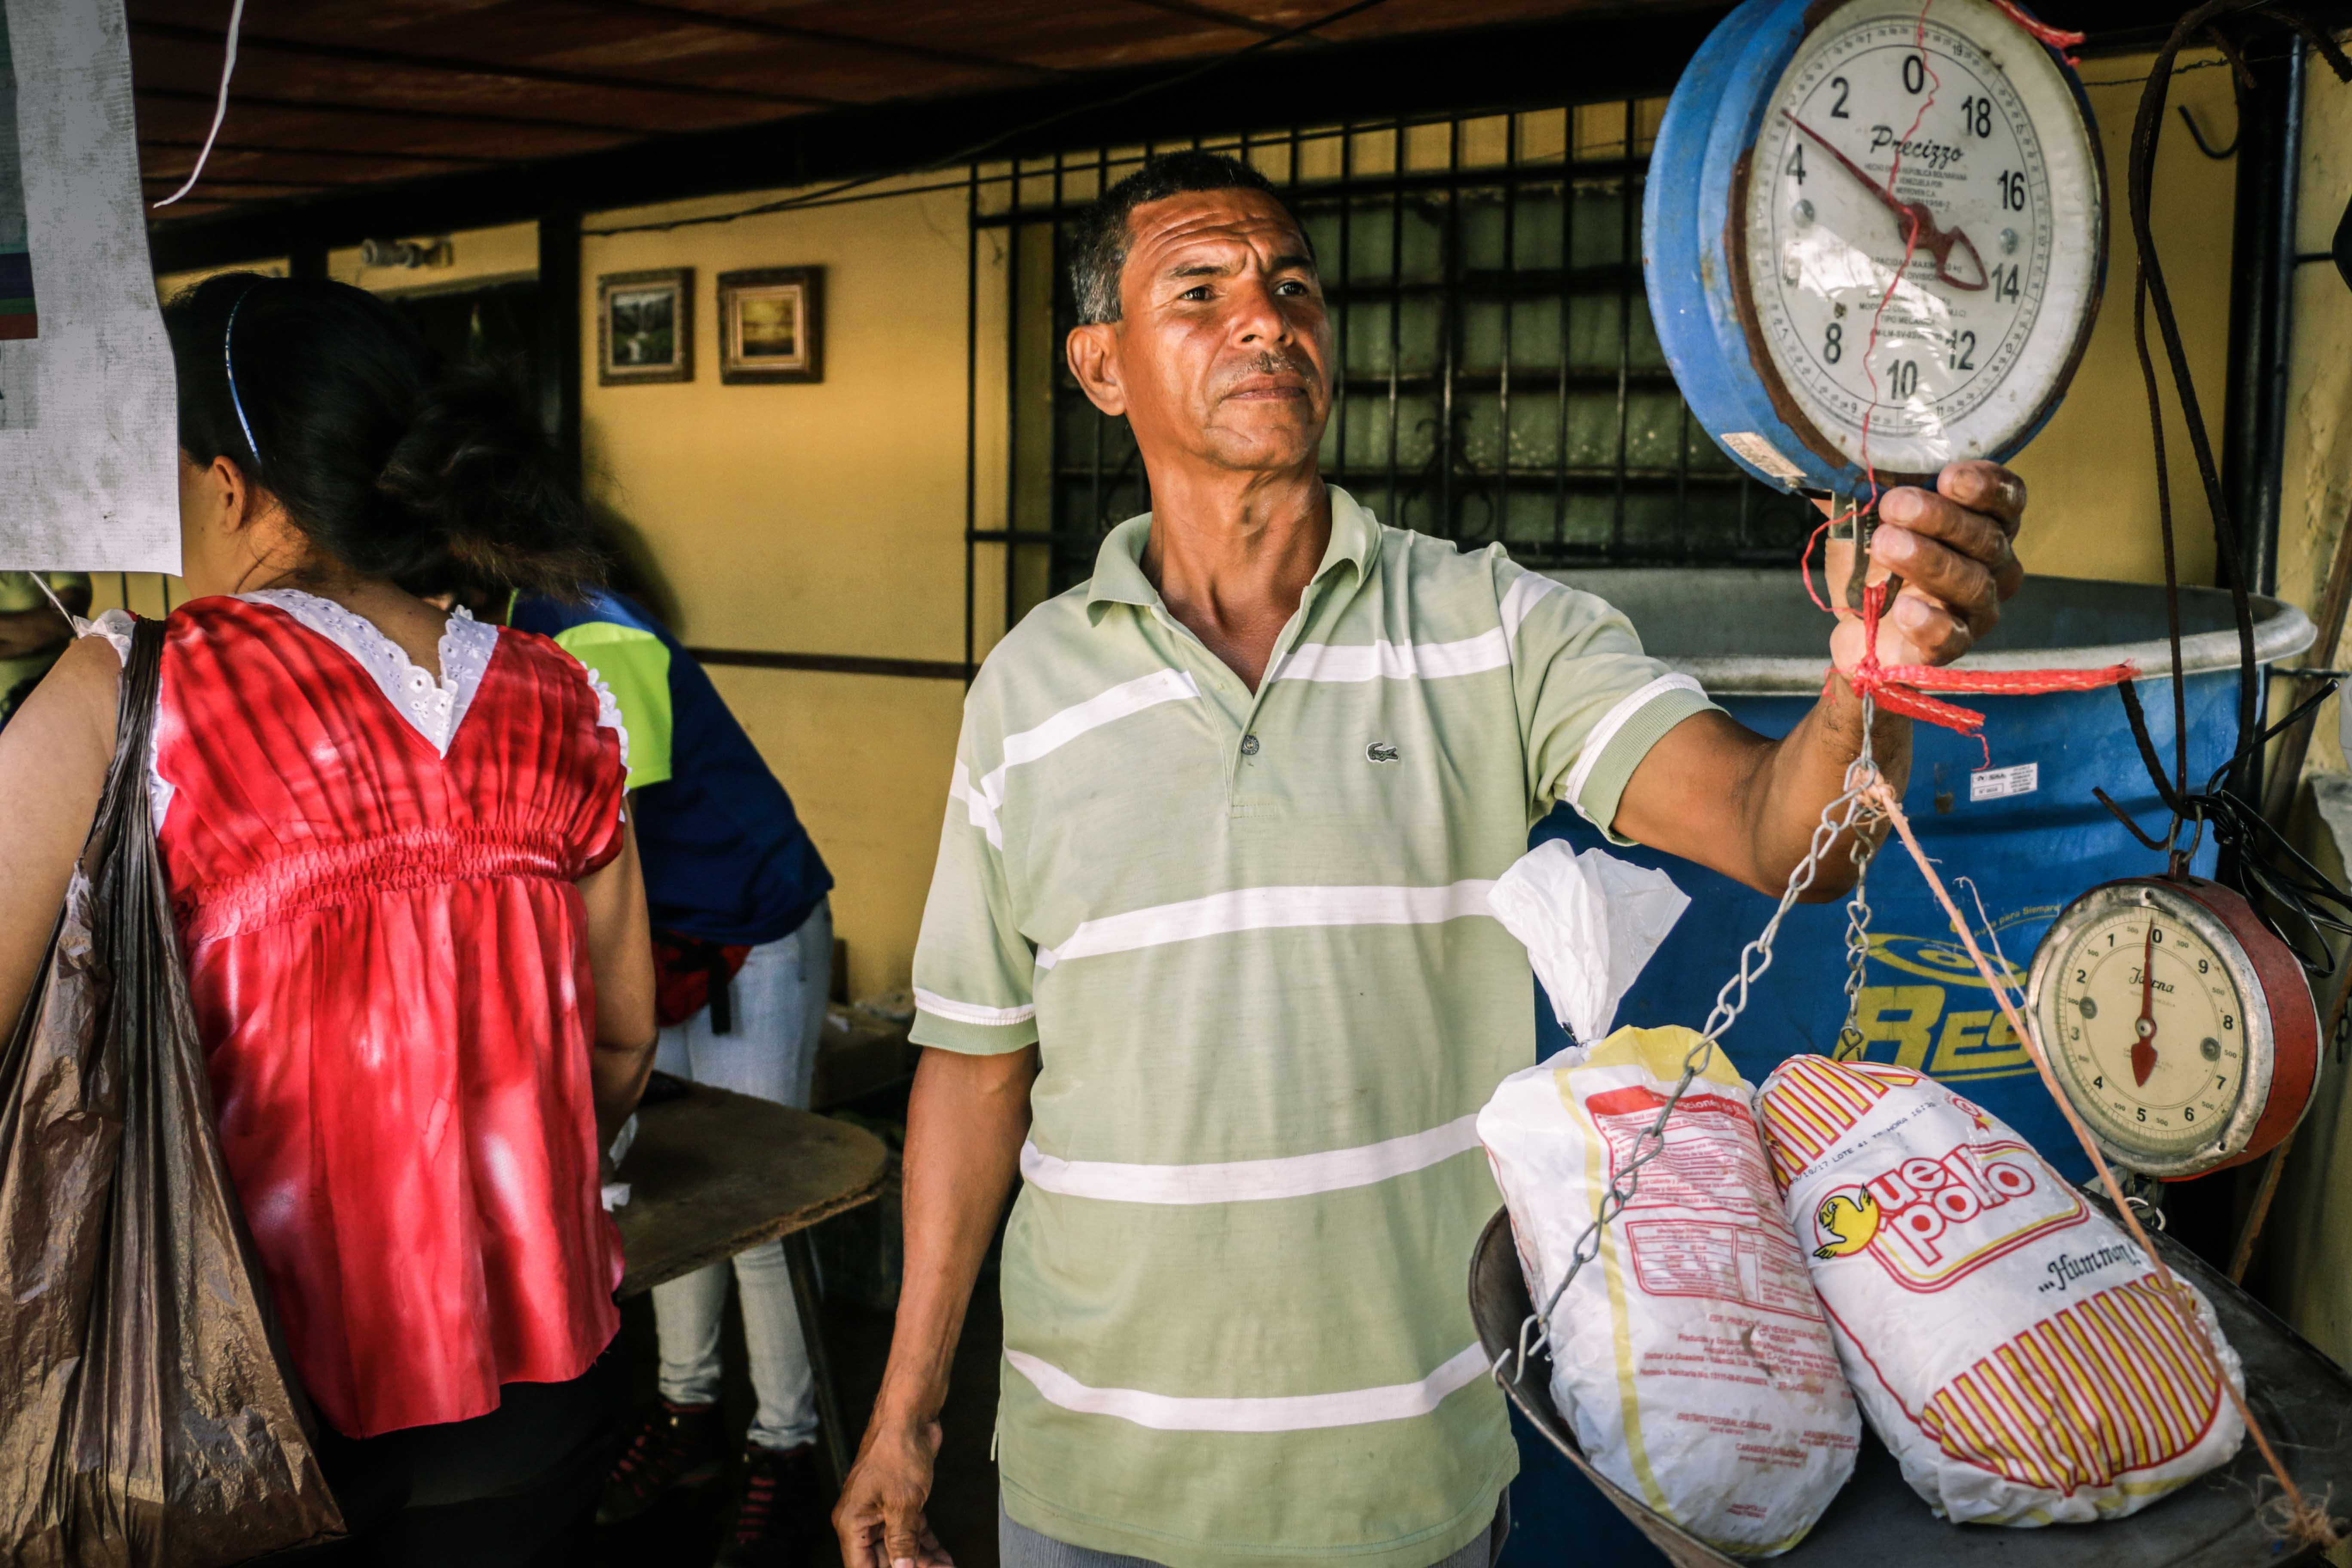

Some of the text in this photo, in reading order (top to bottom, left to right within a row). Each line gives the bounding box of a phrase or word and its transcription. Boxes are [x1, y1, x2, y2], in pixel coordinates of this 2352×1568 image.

[1953, 44, 1963, 56] 19
[1903, 55, 1924, 94] 0
[1831, 77, 1849, 119] 2
[1961, 95, 1991, 138] 18
[1870, 125, 1964, 169] Precizzo
[1785, 143, 1807, 185] 4
[1997, 169, 2025, 211] 16
[1991, 263, 2020, 304] 14
[1824, 323, 1842, 364] 8
[1945, 329, 1975, 370] 12
[1886, 359, 1917, 400] 10
[2126, 926, 2139, 934] 500
[2152, 928, 2162, 943] 0
[2107, 933, 2114, 947] 1
[2176, 940, 2189, 948] 500
[2087, 949, 2099, 957] 500
[2198, 959, 2208, 974] 9
[2076, 969, 2086, 984] 2
[2212, 987, 2225, 996] 500
[2067, 997, 2079, 1005] 500
[2223, 1014, 2233, 1030] 8
[2070, 1026, 2080, 1041] 3
[2224, 1049, 2237, 1059] 500
[2093, 1076, 2103, 1090] 4
[2216, 1075, 2226, 1090] 7
[2114, 1102, 2126, 1112] 500
[2201, 1100, 2214, 1110] 500
[2136, 1107, 2147, 1122] 5
[2184, 1106, 2194, 1122] 6
[2156, 1117, 2168, 1127] 500
[1831, 1147, 1854, 1163] LOTE
[1886, 1117, 1908, 1132] HORA
